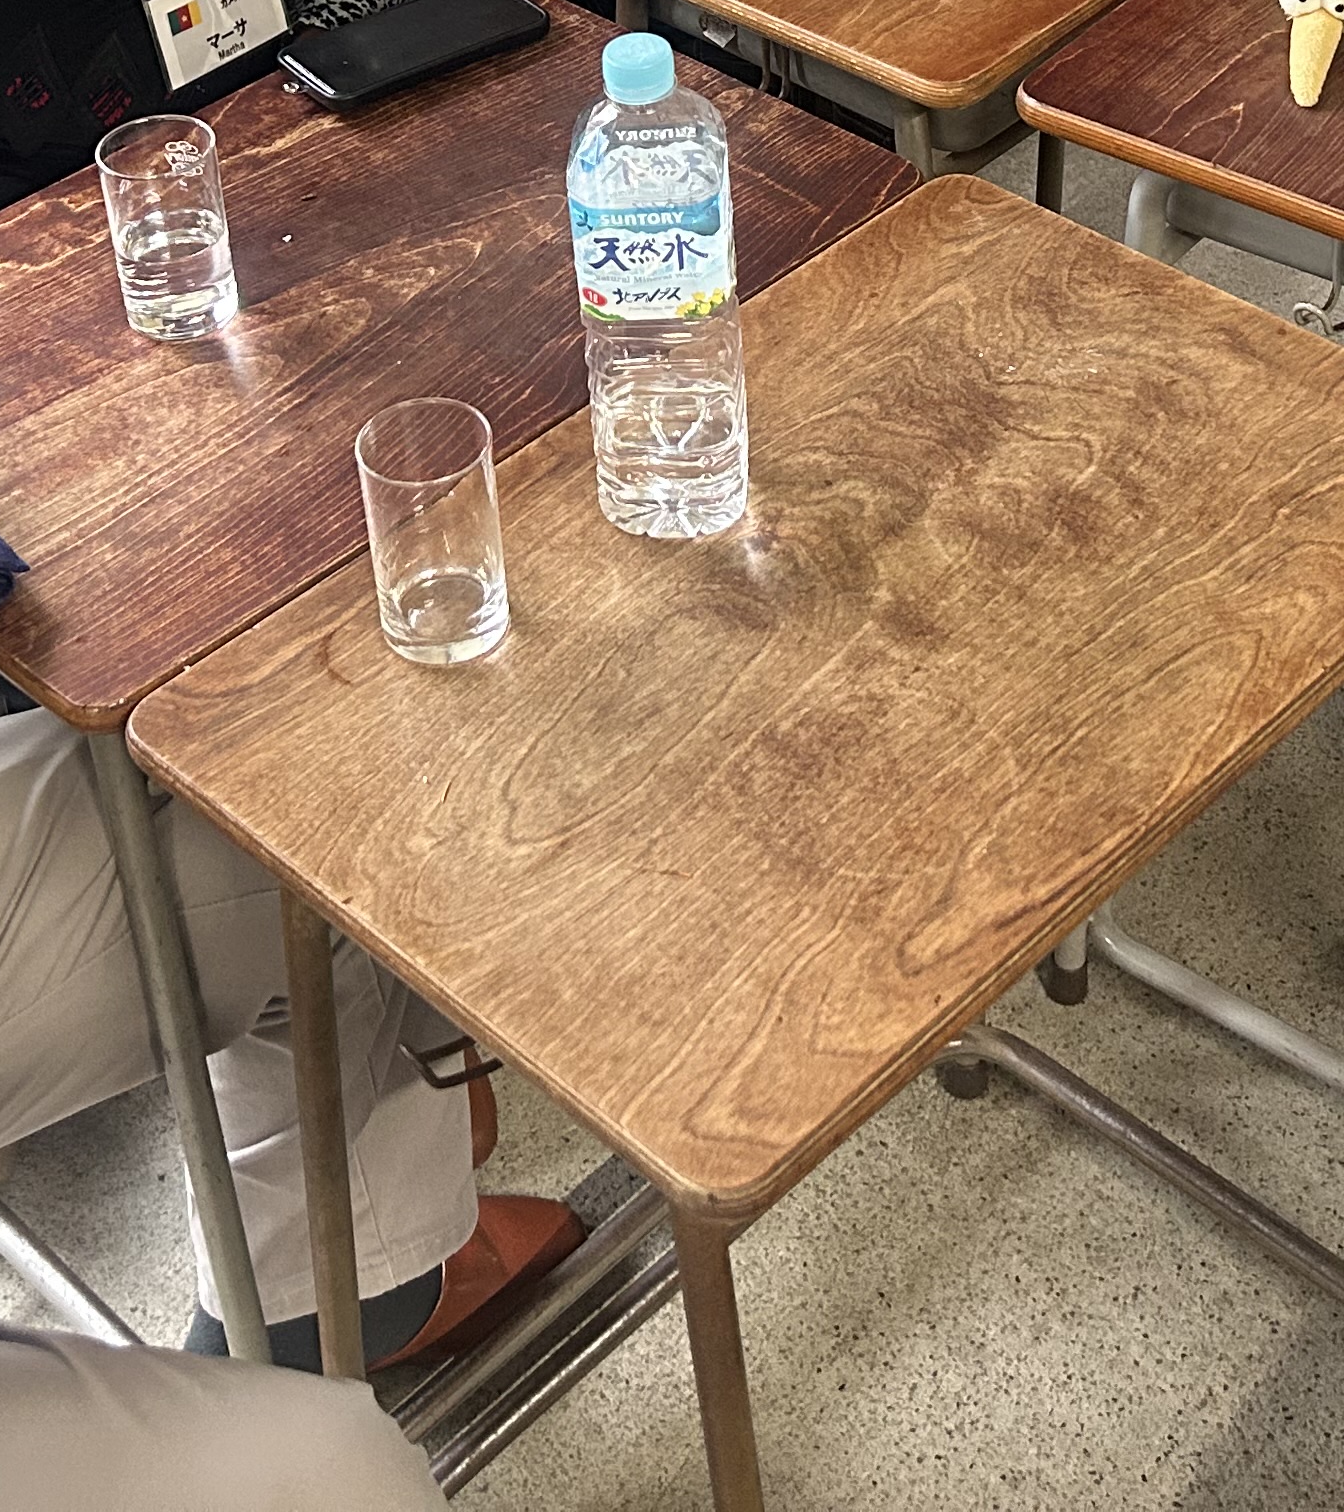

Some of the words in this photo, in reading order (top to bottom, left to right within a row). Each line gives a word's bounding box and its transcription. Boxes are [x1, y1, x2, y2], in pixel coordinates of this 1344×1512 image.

[206, 17, 248, 49] マーサ
[218, 41, 246, 61] Martha
[599, 210, 685, 227] SUNTORY
[588, 233, 709, 272] 天然水
[612, 286, 682, 306] 北アルプス
